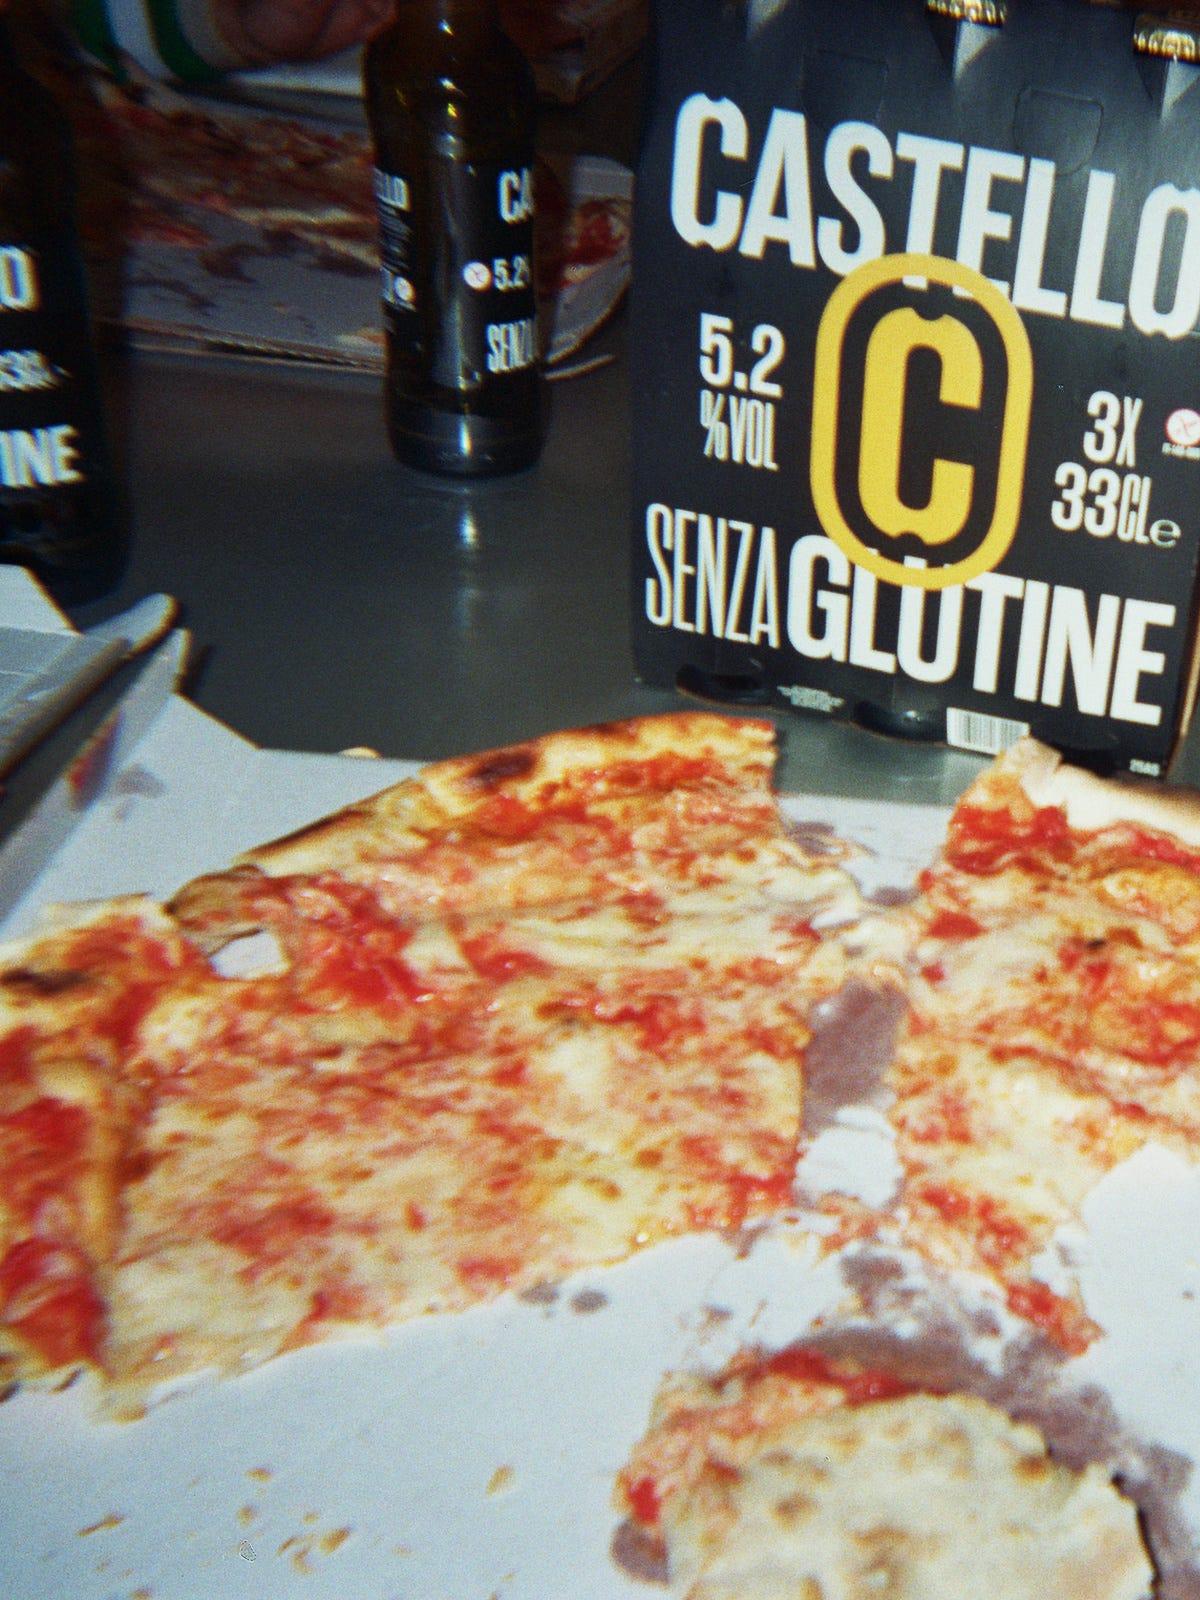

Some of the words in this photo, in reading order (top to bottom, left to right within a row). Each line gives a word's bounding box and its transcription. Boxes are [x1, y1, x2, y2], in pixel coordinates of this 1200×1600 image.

[700, 312, 786, 399] 5.2
[1082, 390, 1144, 468] 3X
[645, 503, 781, 649] SENZA
[786, 534, 1177, 727] GLUTINE
